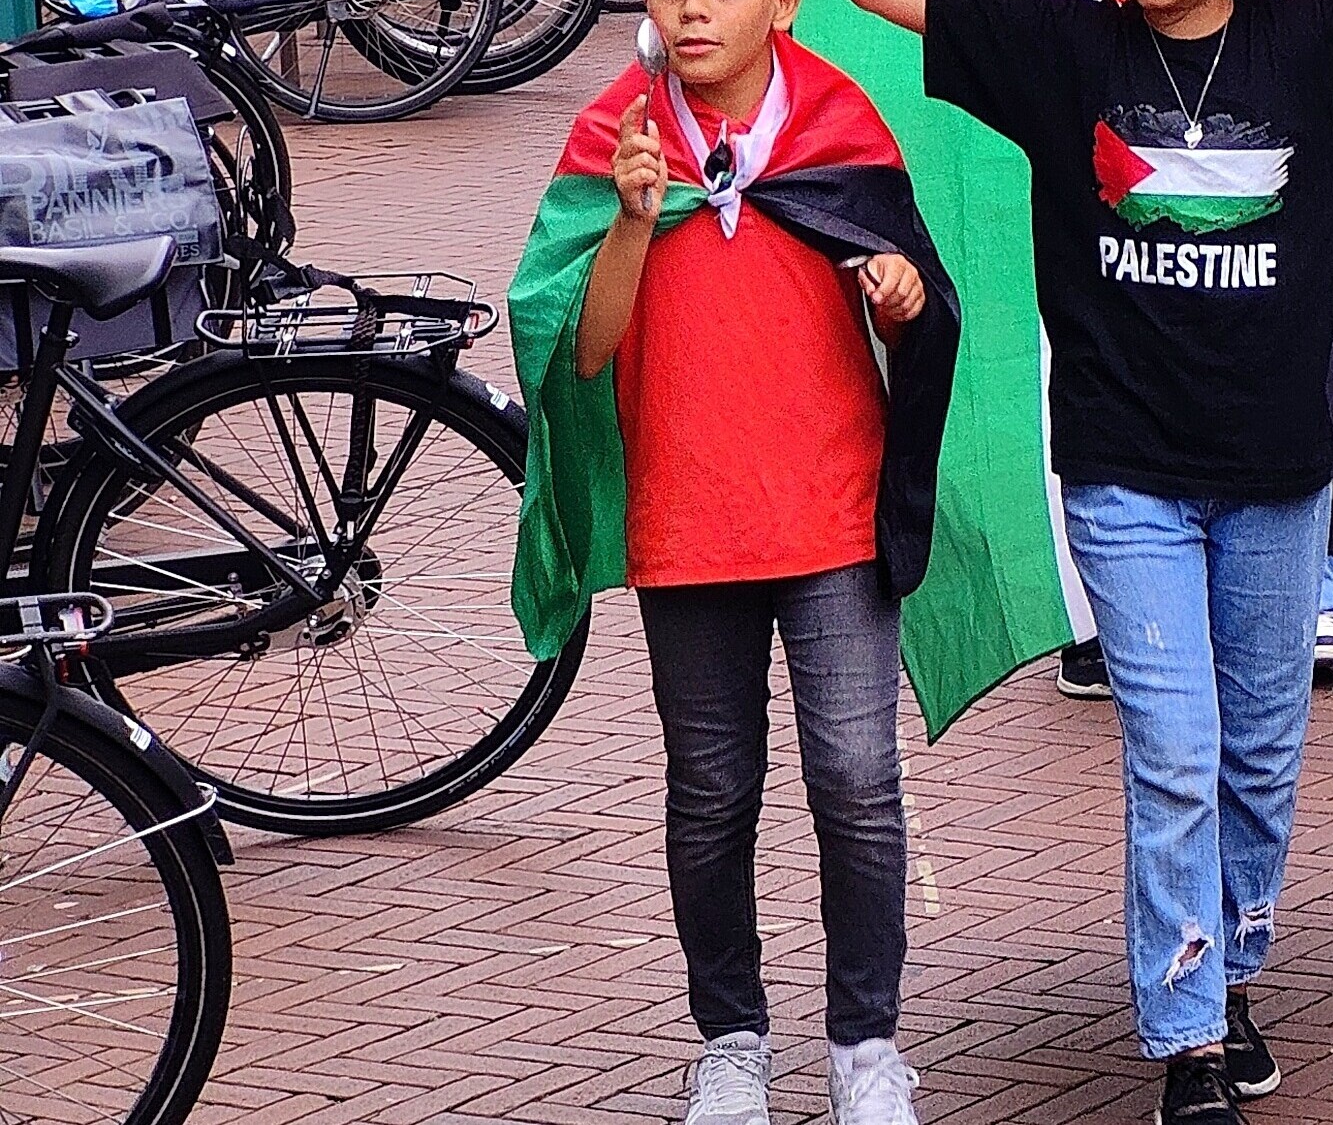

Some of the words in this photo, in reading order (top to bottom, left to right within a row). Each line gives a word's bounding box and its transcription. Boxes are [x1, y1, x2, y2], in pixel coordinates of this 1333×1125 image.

[30, 217, 105, 244] BASIL
[113, 215, 135, 236] &
[1099, 235, 1277, 289] PALESTINE
